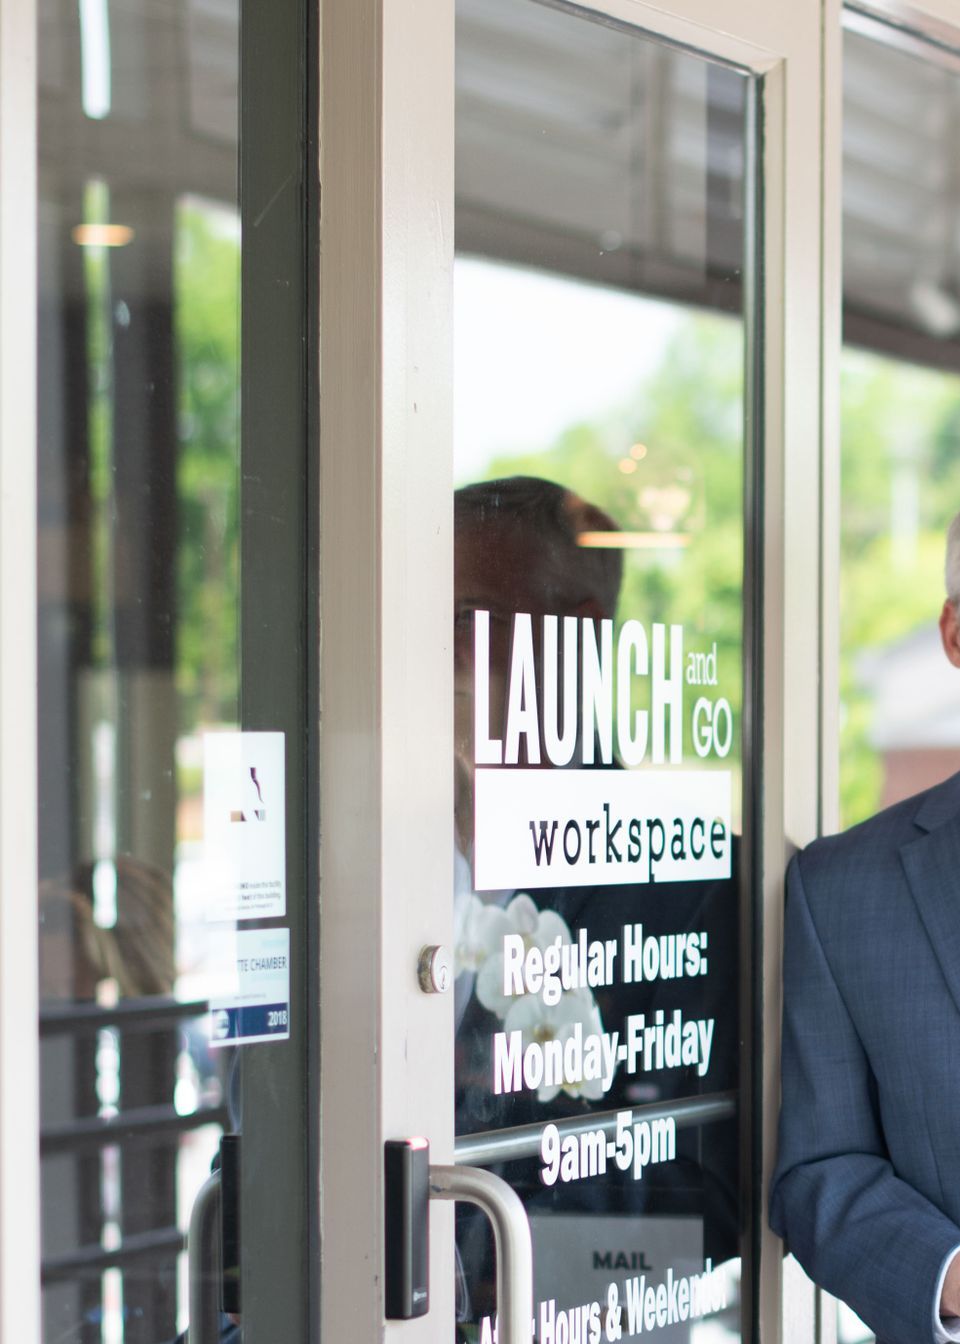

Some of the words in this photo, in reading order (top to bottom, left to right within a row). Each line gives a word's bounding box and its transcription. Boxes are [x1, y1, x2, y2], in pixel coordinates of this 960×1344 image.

[475, 610, 683, 766] LAUNCH
[686, 642, 718, 685] and
[692, 696, 733, 758] GO
[529, 803, 727, 883] workspace
[250, 956, 287, 971] CHAMBER
[503, 928, 617, 1006] Regular
[623, 923, 708, 983] Hours:
[267, 1010, 287, 1026] 2018
[494, 1009, 714, 1095] Monday-Friday
[541, 1110, 676, 1186] 9am-5pm
[592, 1251, 653, 1271] MAIL
[606, 1282, 622, 1342] &
